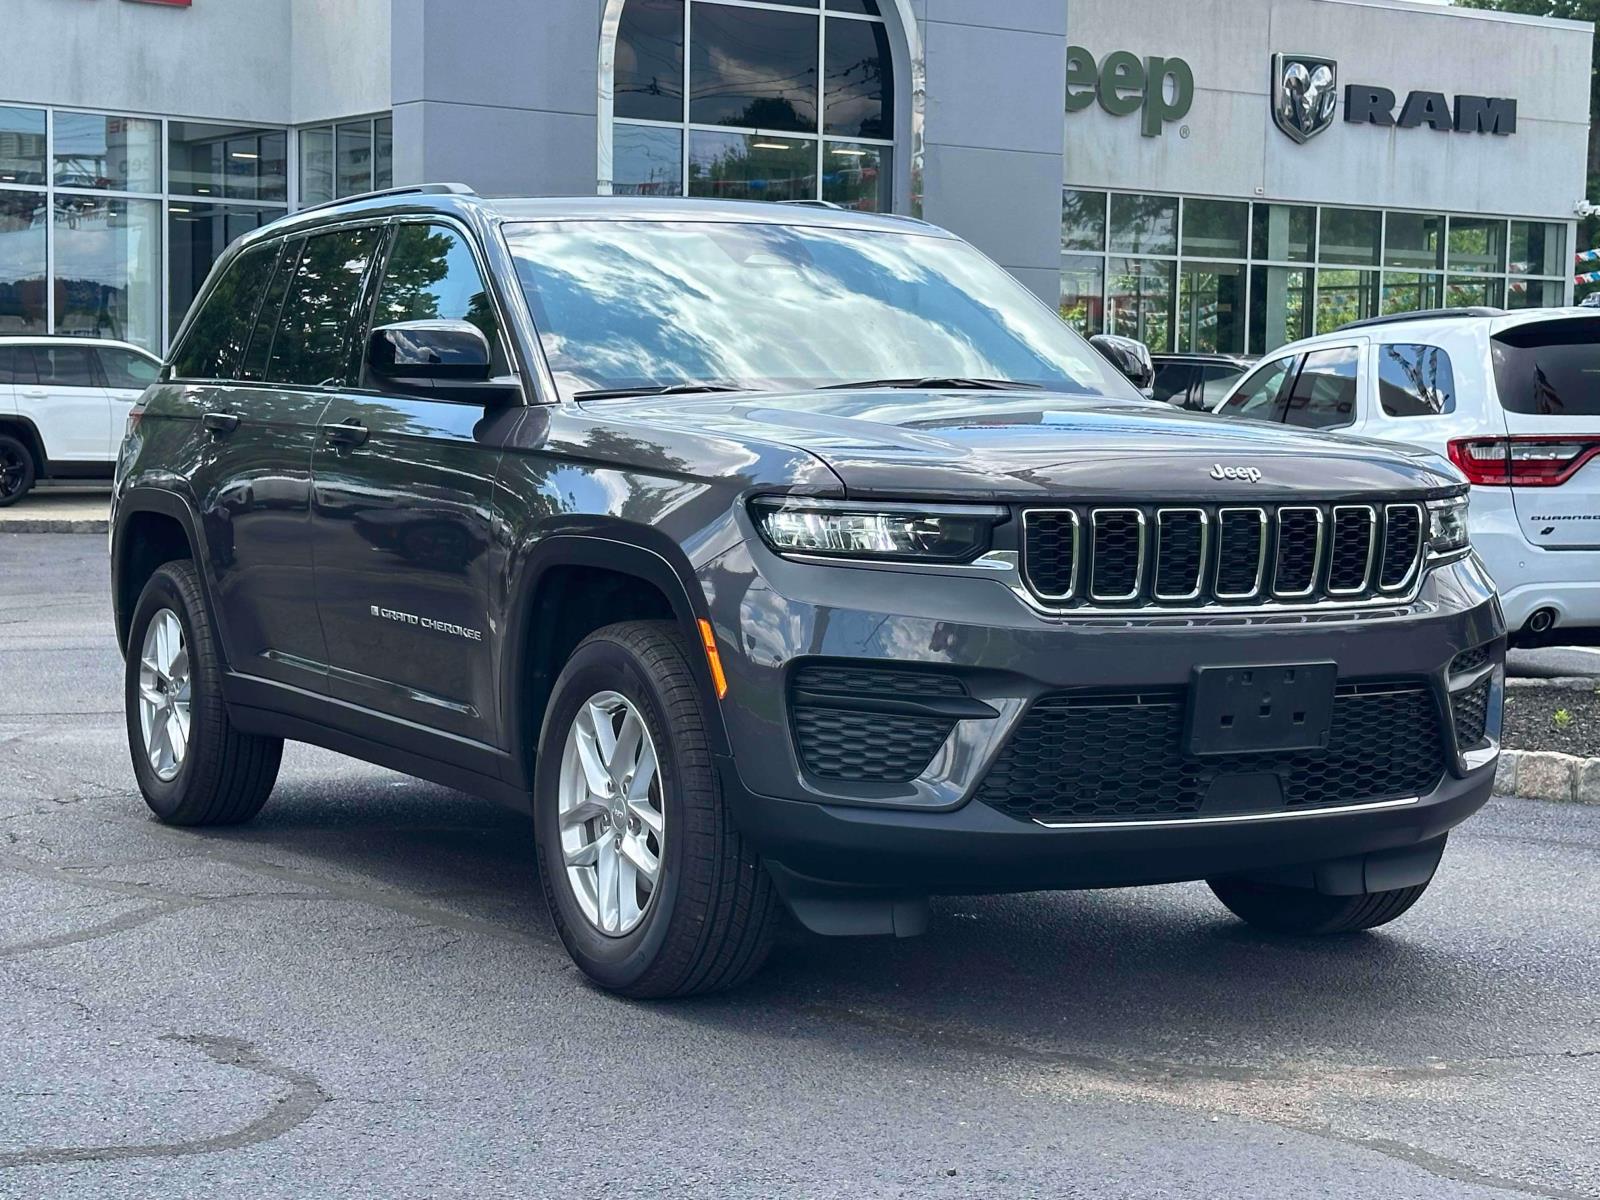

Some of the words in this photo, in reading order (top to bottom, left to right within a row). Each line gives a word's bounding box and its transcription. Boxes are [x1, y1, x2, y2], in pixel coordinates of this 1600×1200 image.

[1065, 45, 1194, 138] eep
[1344, 84, 1517, 136] RAM
[1210, 463, 1262, 483] Jeep
[380, 608, 419, 625] GRAND
[421, 617, 482, 641] CHEROKEE
